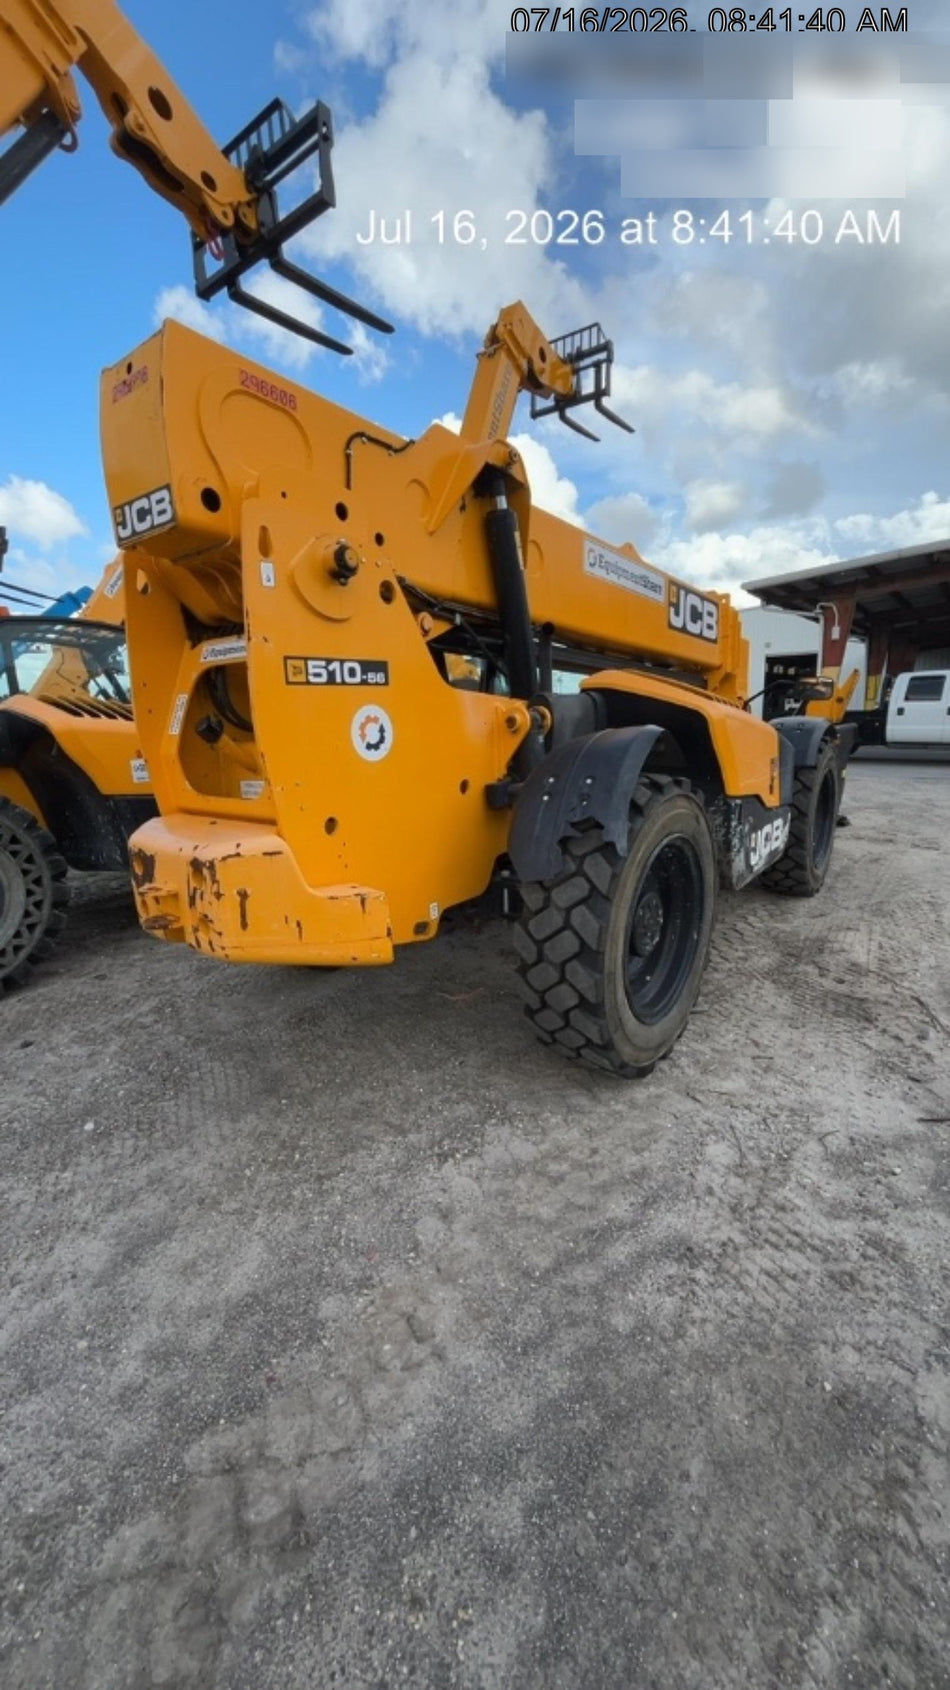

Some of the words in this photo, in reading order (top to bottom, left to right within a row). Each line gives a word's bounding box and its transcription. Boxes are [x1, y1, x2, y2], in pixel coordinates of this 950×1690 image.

[116, 488, 174, 538] JCB
[669, 587, 718, 640] JCB
[306, 660, 386, 684] 510-56
[750, 817, 784, 866] JCB
